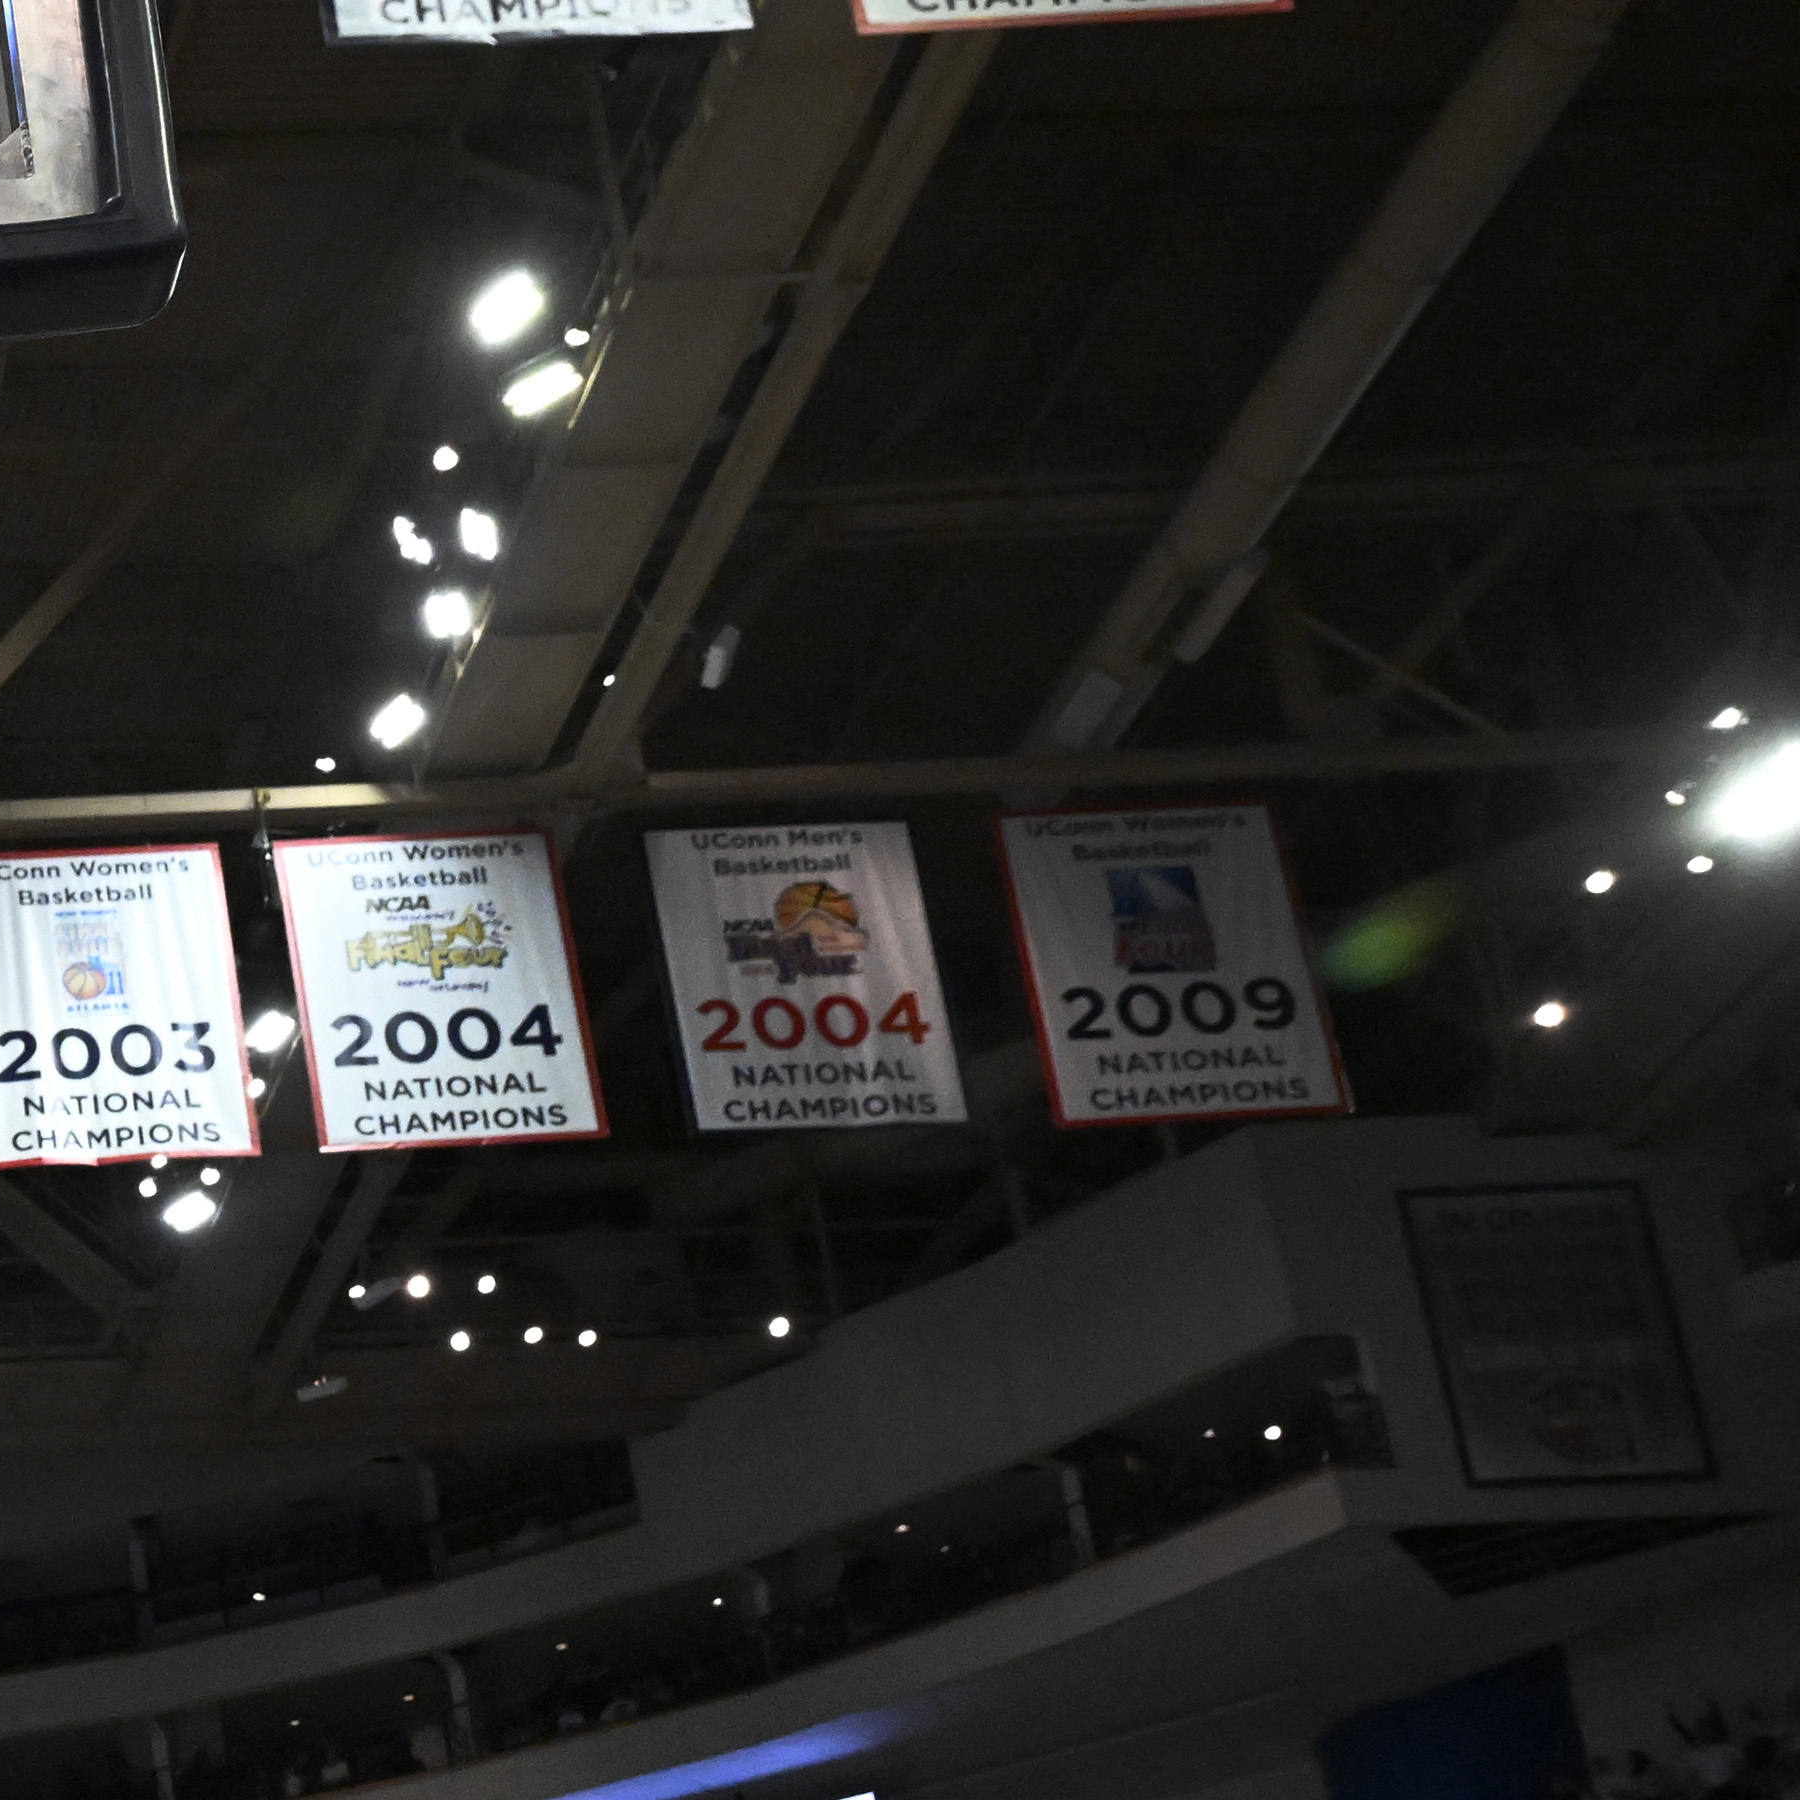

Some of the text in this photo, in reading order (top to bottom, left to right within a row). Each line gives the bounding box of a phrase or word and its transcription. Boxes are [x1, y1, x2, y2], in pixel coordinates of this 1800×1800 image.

[306, 838, 525, 868] UConn Women's
[690, 827, 863, 851] UConn Men's
[70, 856, 189, 877] Women's
[351, 866, 488, 892] Basketball
[712, 852, 852, 877] Basketball
[17, 883, 153, 906] Basketball
[694, 990, 932, 1052] 2004
[1060, 977, 1297, 1040] 2009
[330, 1003, 563, 1068] 2004
[731, 1059, 917, 1088] NATIONAL
[1096, 1045, 1287, 1076] NATIONAL
[363, 1071, 548, 1101] NATIONAL
[1089, 1077, 1311, 1112] CHAMPIONS
[23, 1088, 203, 1117] NATIONAL
[722, 1093, 938, 1123] CHAMPIONS
[354, 1104, 569, 1137] CHAMPIONS
[11, 1122, 221, 1151] CHAMPIONS
